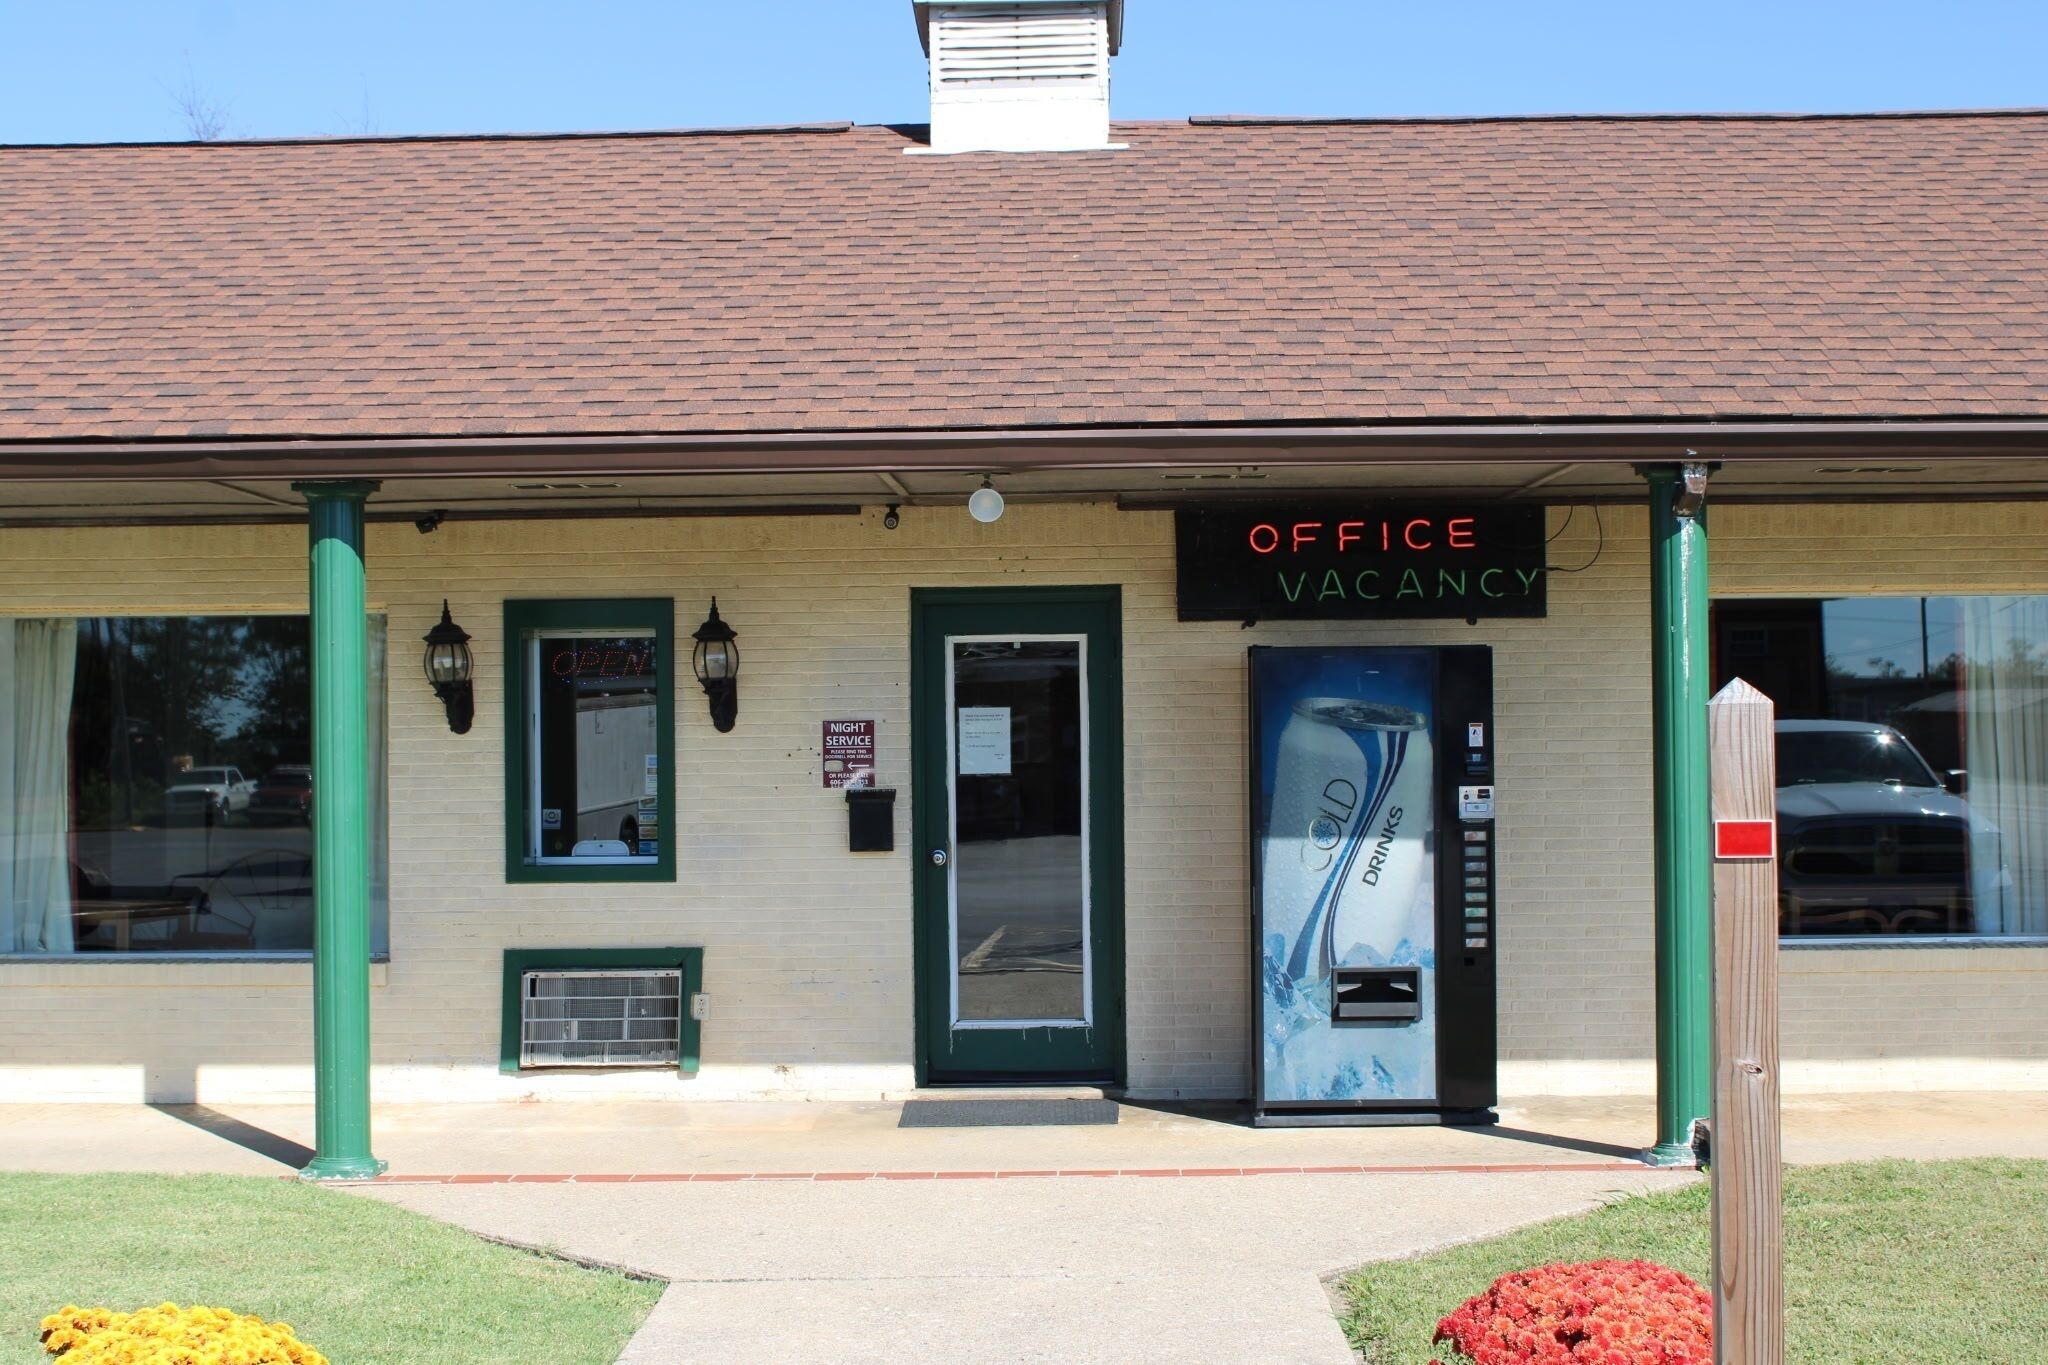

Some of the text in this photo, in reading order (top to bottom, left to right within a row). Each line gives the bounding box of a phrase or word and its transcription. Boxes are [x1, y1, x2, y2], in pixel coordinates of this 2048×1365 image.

[1249, 518, 1477, 553] OFFICE
[1277, 567, 1539, 602] VACANCY
[552, 650, 649, 678] OPEN
[825, 735, 872, 746] SERVICE
[830, 722, 866, 733] NIGHT
[1301, 778, 1358, 872] COLD
[1361, 805, 1404, 887] DRINKS
